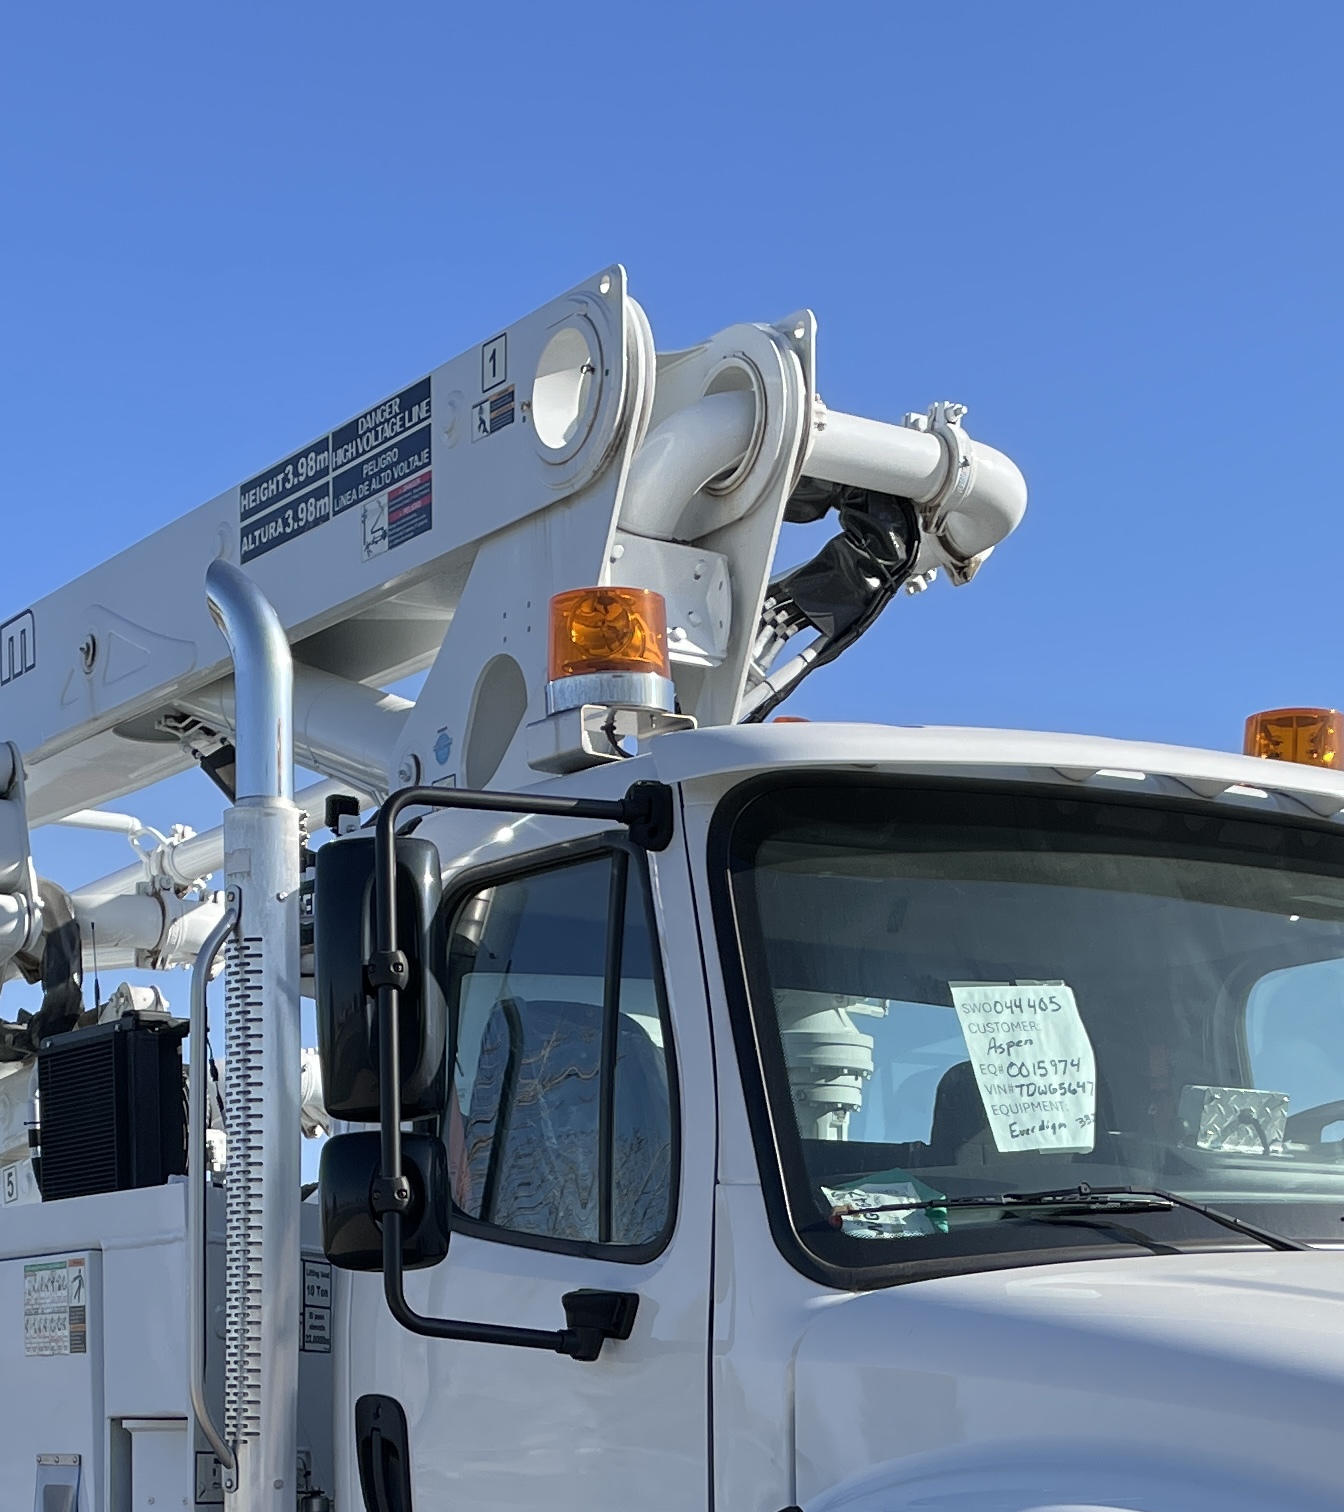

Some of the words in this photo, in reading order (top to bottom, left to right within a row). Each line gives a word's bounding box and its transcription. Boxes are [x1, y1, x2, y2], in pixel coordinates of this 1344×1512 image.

[488, 348, 497, 378] 1
[358, 397, 401, 435] DANGER
[332, 439, 356, 469] HIGH
[356, 412, 404, 460] VOLTAGE
[404, 397, 431, 428] LINE
[357, 479, 370, 498] DE
[370, 469, 392, 493] ALTO
[392, 448, 430, 481] VOLTAJE
[362, 447, 399, 479] PELIGRO
[240, 475, 286, 513] HEIGHT
[285, 449, 329, 490] 3.98m
[240, 518, 284, 555] ALTURA
[284, 495, 331, 534] 3.98m
[967, 1020, 1041, 1034] CUSTOMER:
[986, 1036, 1034, 1057] Aspen
[991, 1102, 1070, 1116] EQUIPMENT:
[6, 1171, 14, 1199] 5
